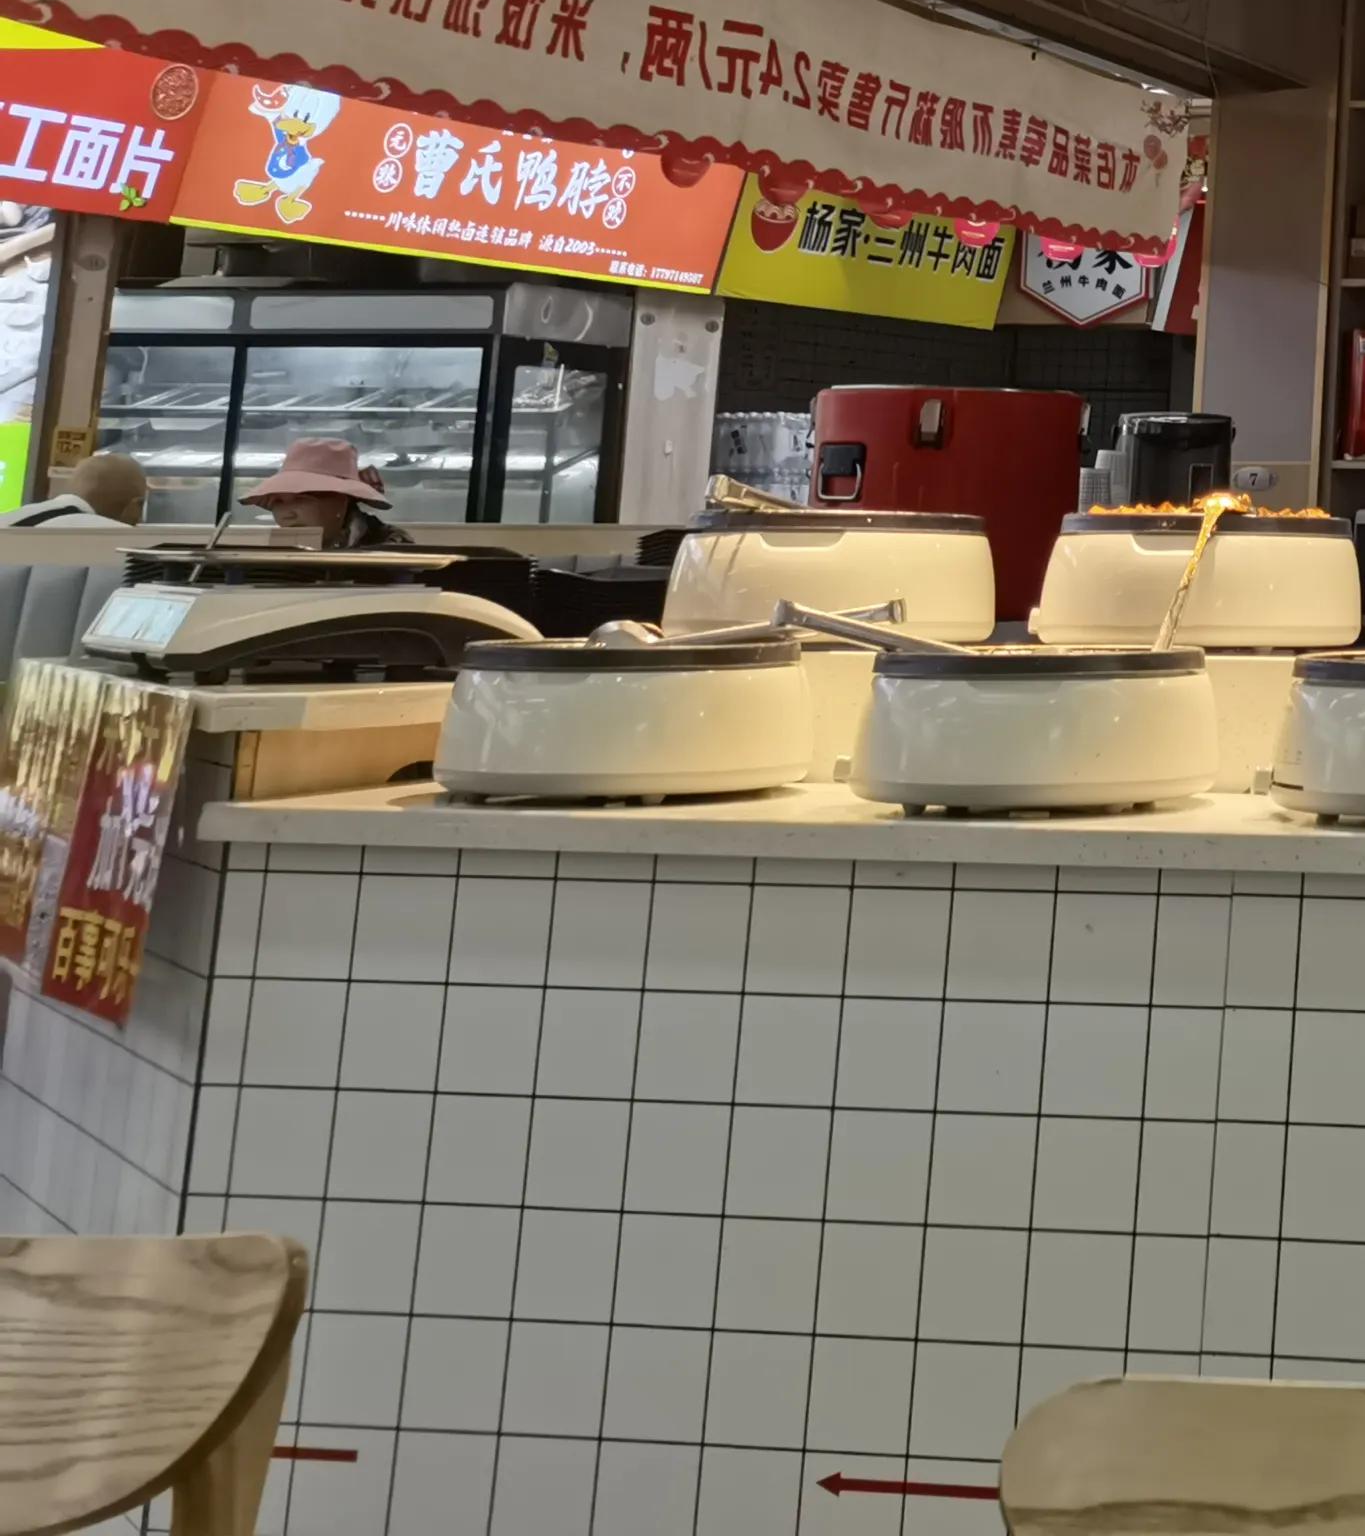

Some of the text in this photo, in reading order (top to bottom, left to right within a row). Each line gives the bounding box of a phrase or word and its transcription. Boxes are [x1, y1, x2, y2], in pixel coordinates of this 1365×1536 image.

[0, 101, 175, 199] 工面片
[413, 128, 613, 220] 曹氏鸭脖
[1041, 275, 1127, 300] 兰州牛肉面
[1250, 473, 1258, 487] 7
